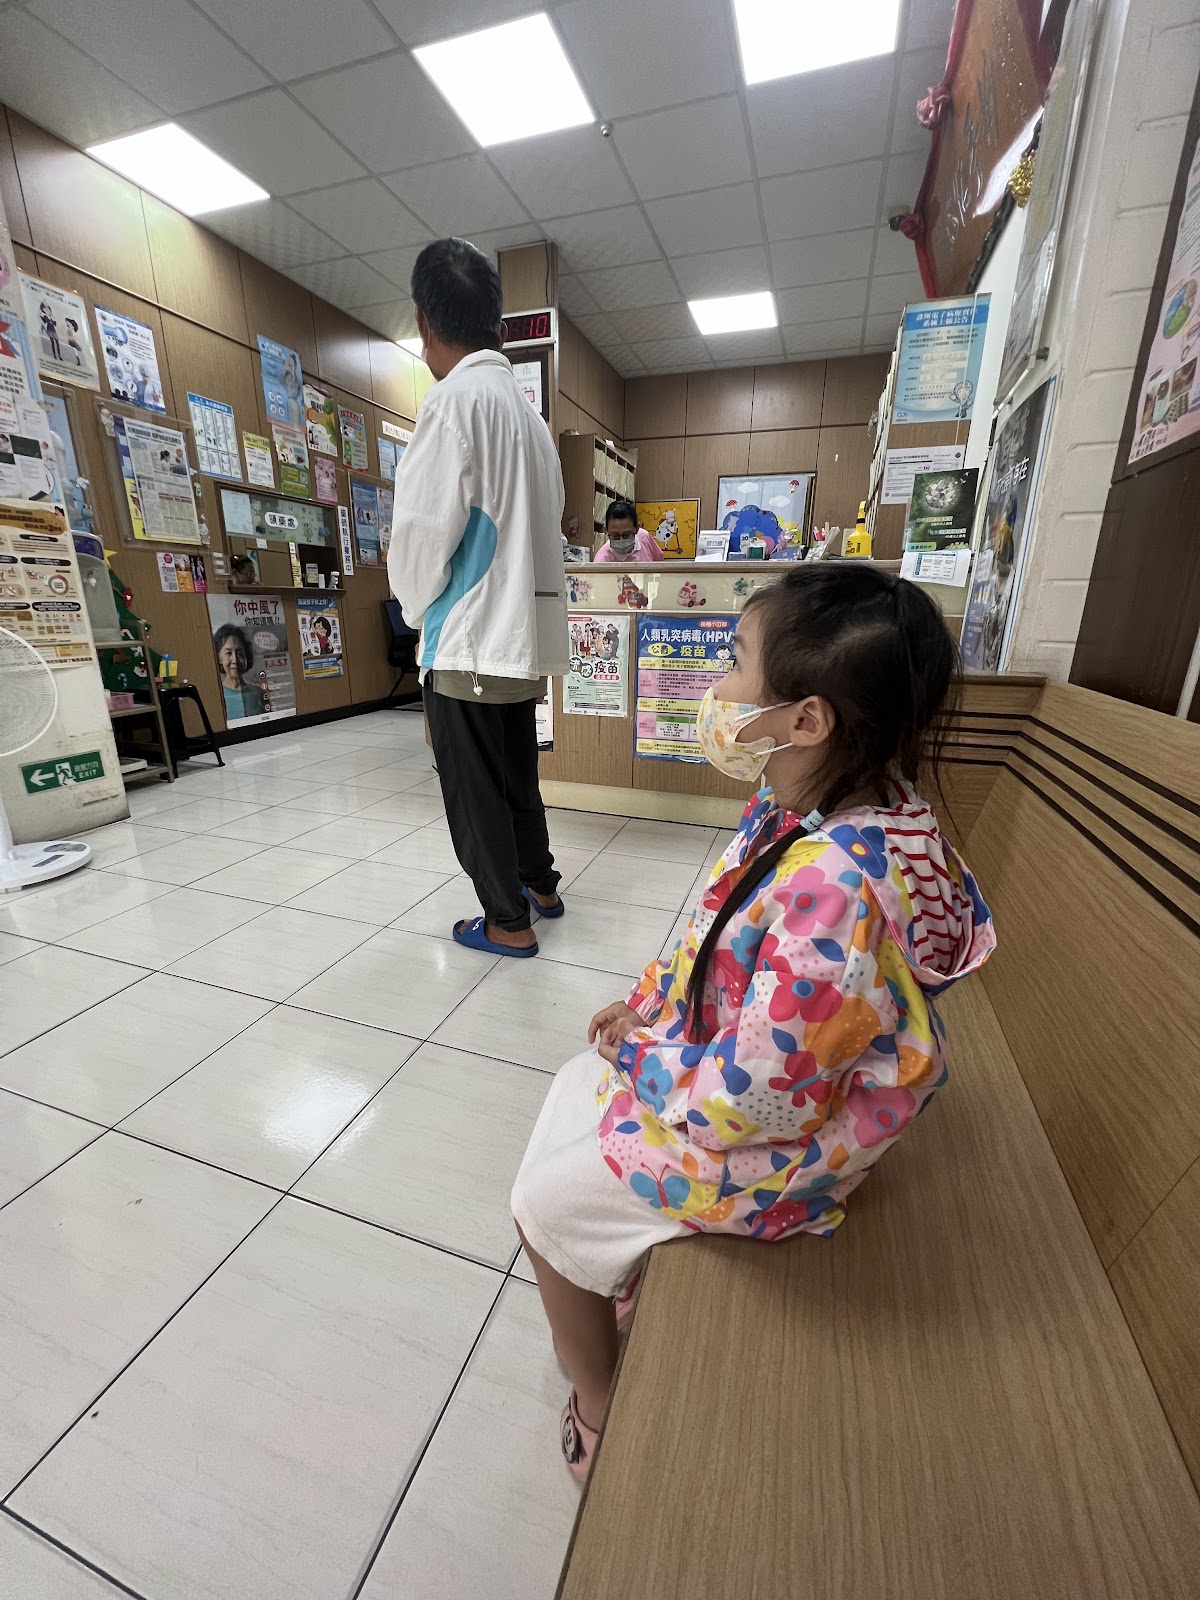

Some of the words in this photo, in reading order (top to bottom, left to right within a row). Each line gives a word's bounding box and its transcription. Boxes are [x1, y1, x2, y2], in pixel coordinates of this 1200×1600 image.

[529, 316, 547, 336] 10
[234, 599, 279, 616] 你中風了
[680, 645, 707, 657] 疫苗
[595, 660, 619, 674] 疫苗
[78, 769, 97, 779] EXIT
